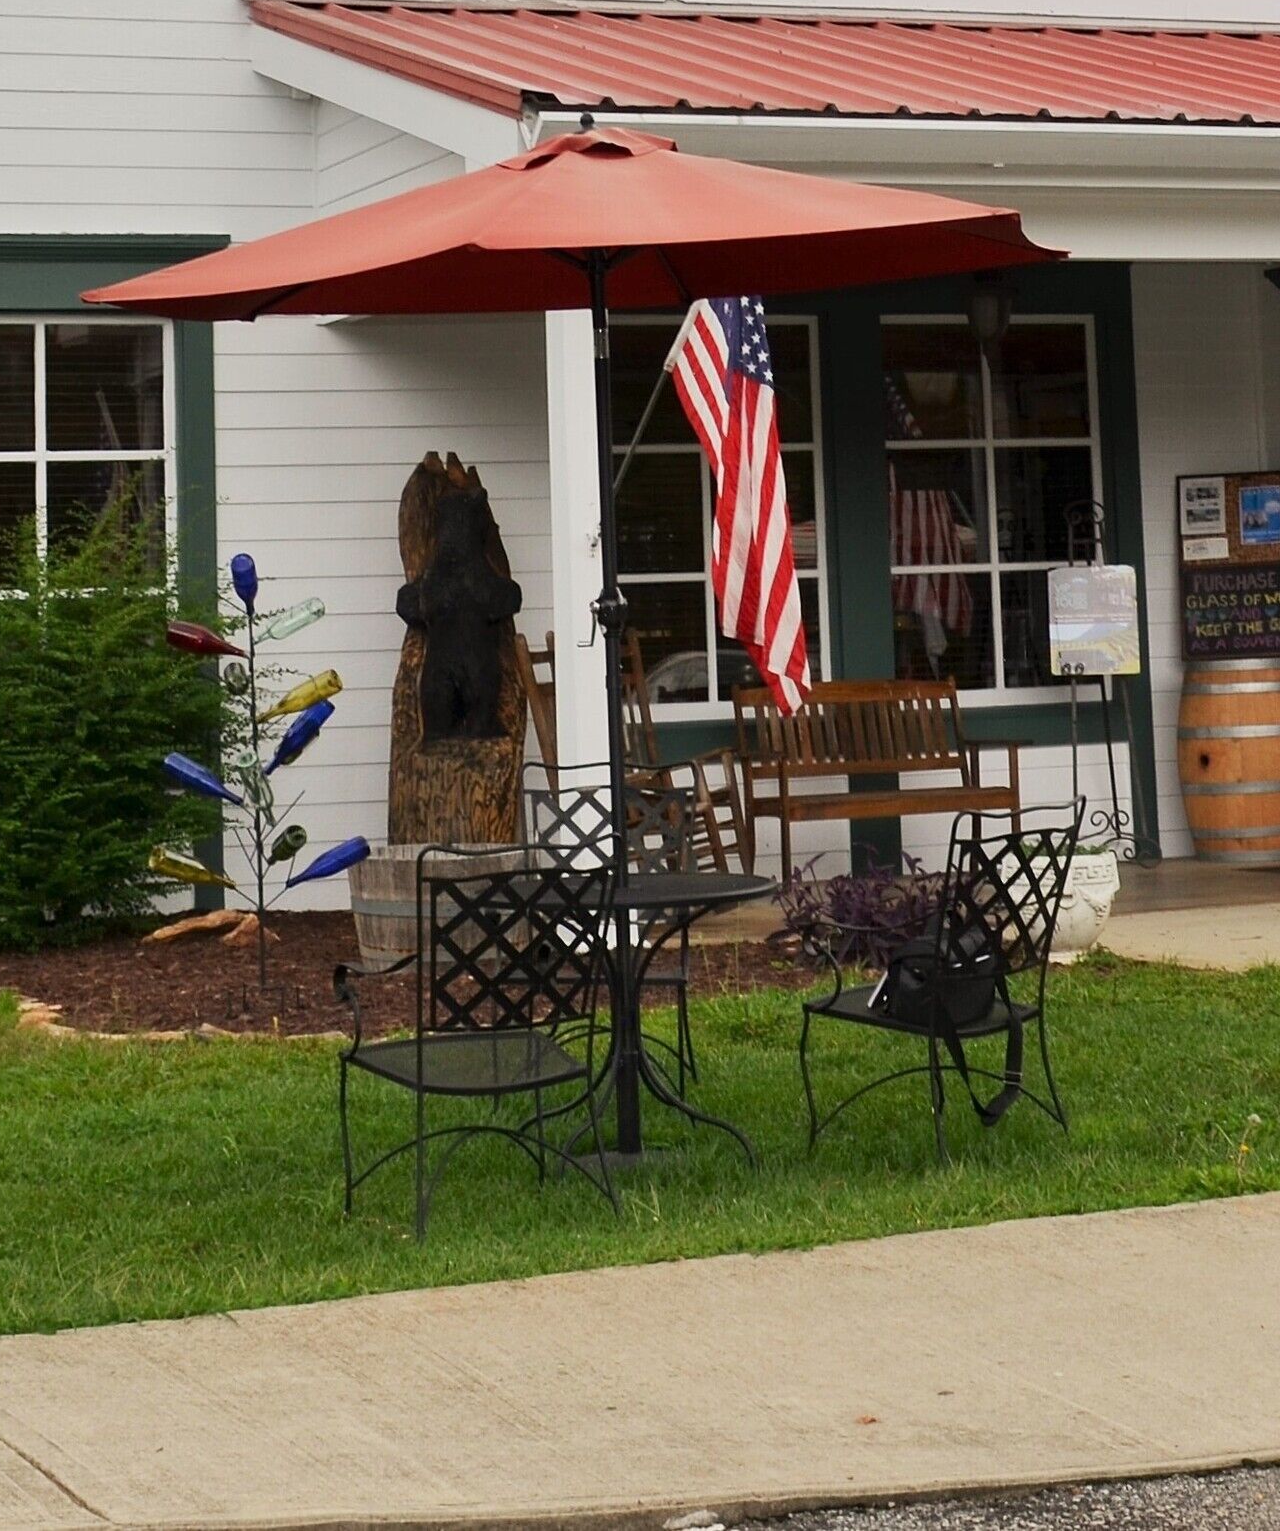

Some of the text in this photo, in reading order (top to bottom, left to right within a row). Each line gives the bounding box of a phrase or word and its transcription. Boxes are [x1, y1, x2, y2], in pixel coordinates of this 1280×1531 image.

[1193, 572, 1277, 592] PURCHASE
[1186, 593, 1237, 609] GLASS
[1243, 594, 1262, 607] OF
[1195, 621, 1233, 638] KEEP
[1236, 620, 1264, 635] THE
